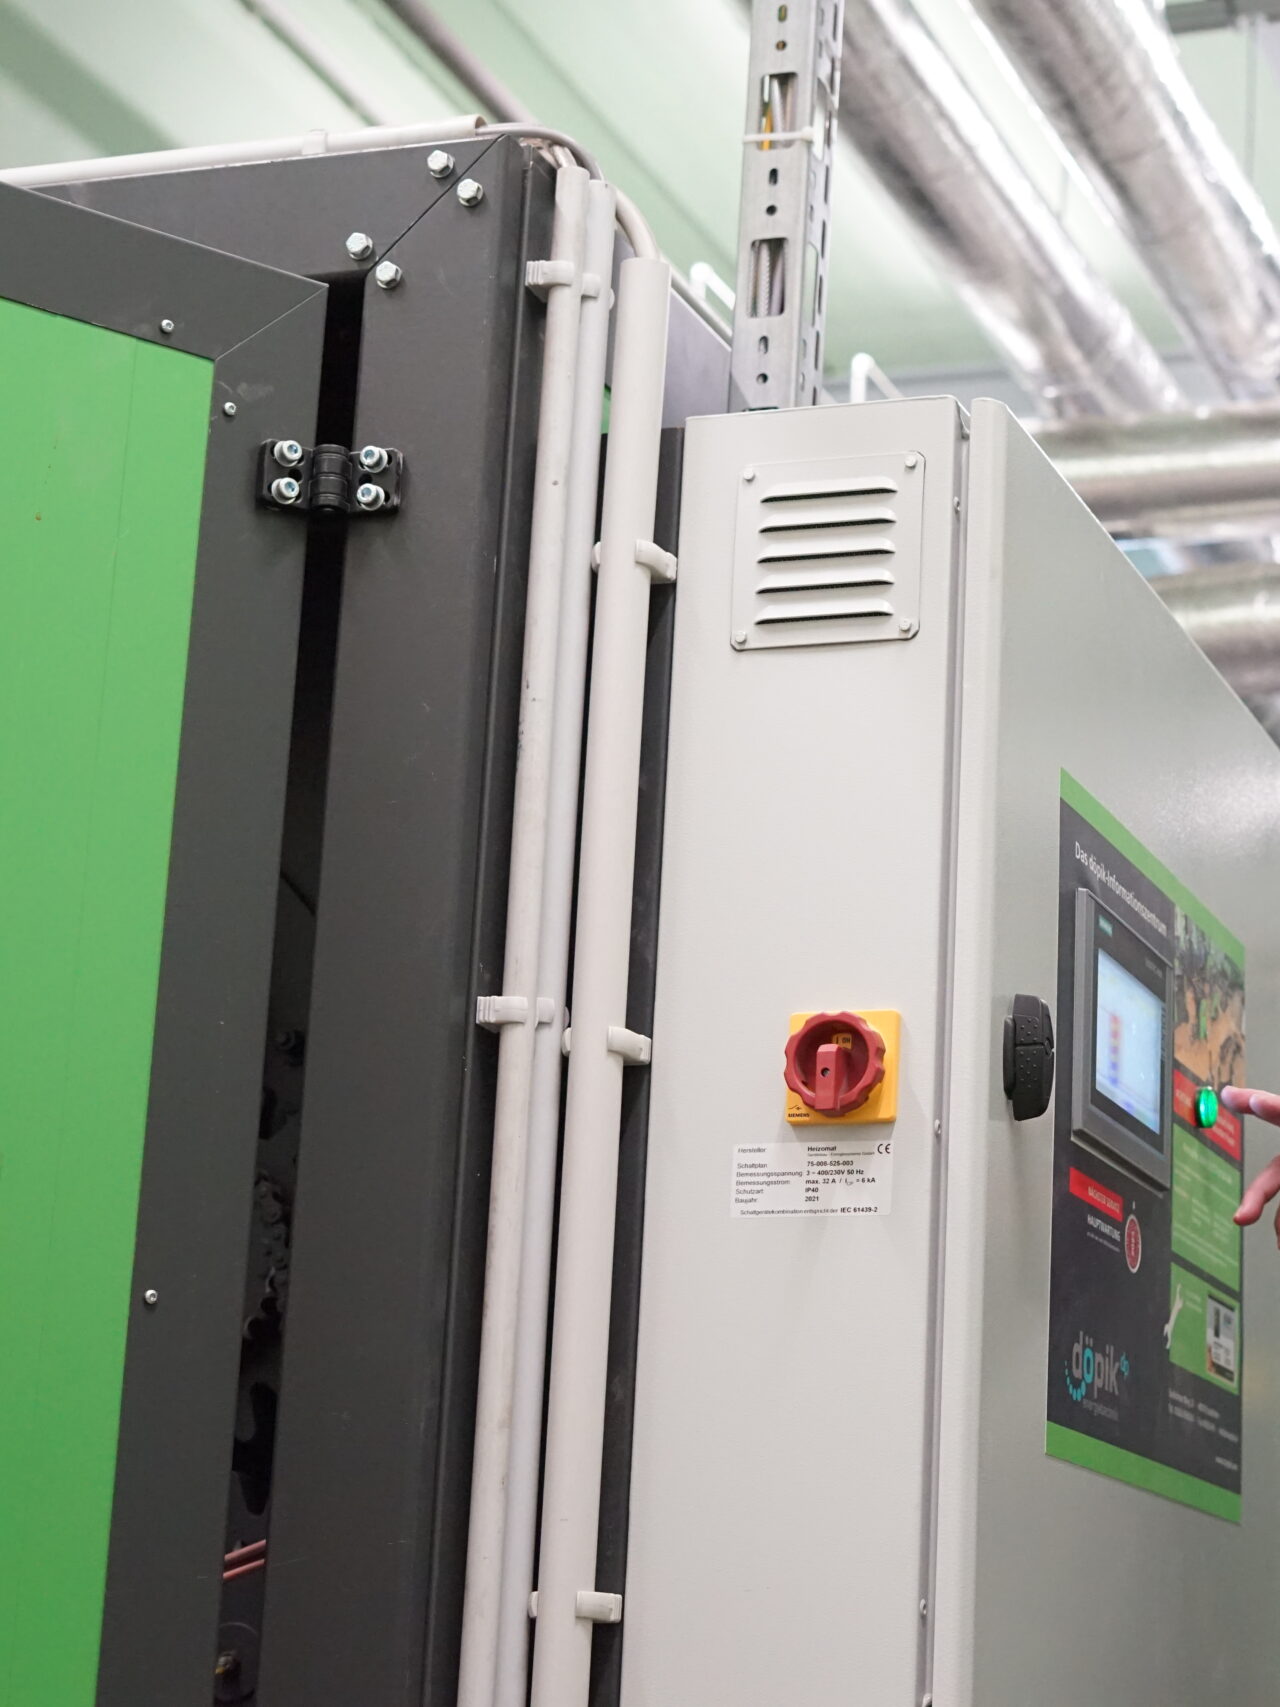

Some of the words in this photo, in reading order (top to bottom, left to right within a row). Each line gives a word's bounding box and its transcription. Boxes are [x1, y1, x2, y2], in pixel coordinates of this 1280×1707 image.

[1075, 841, 1088, 866] Das
[877, 1143, 891, 1155] CE
[1072, 1330, 1120, 1399] döpik
